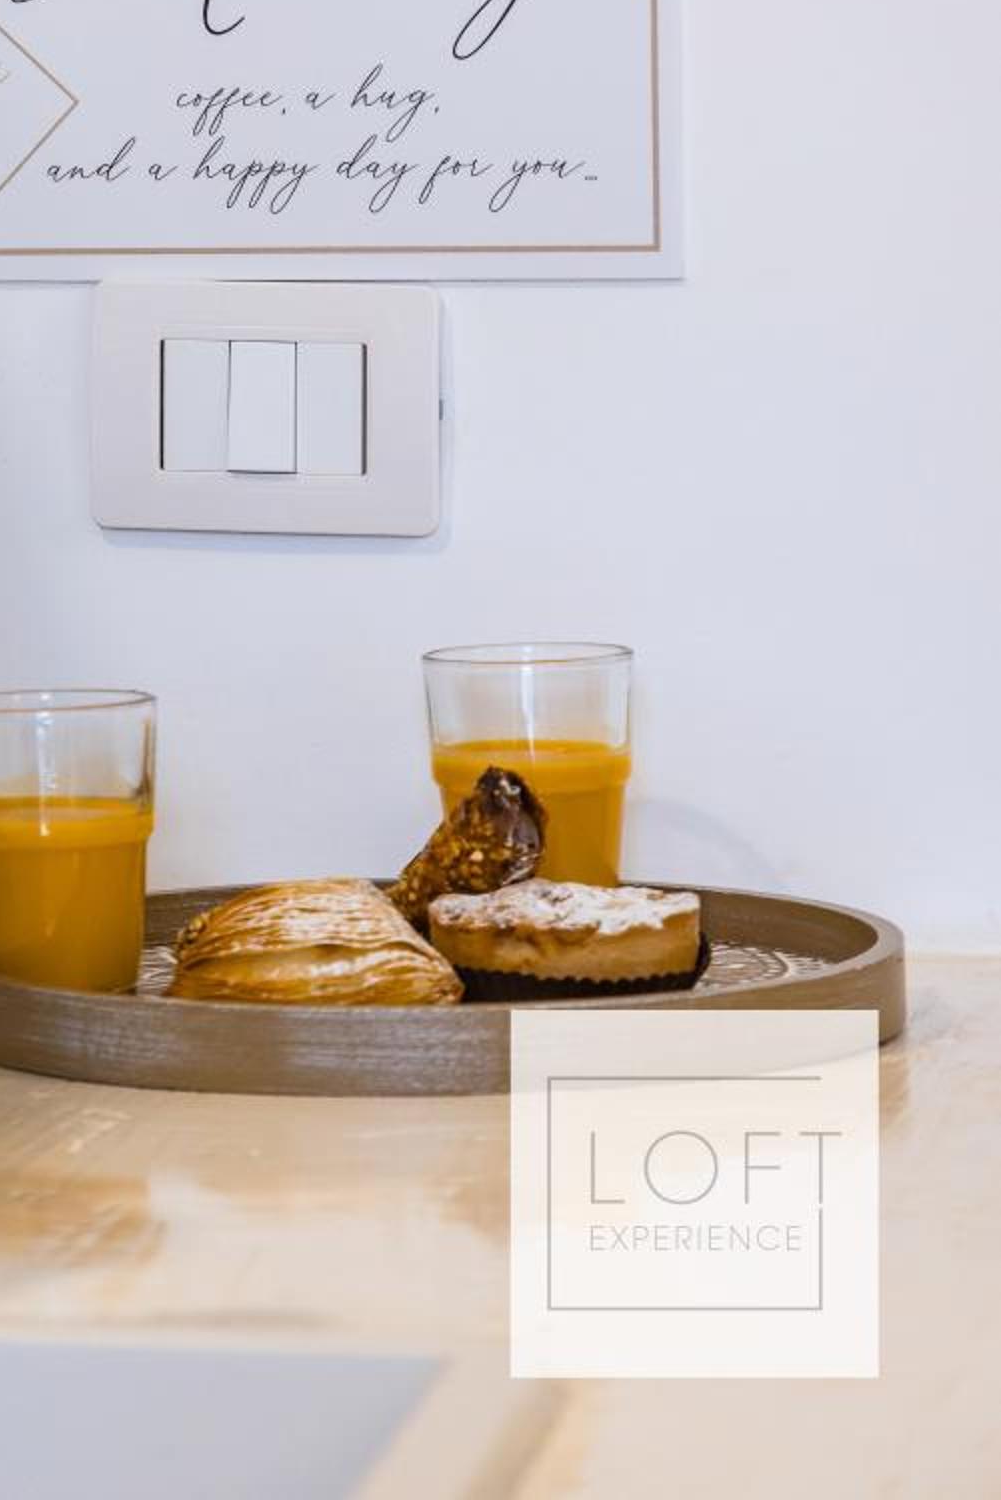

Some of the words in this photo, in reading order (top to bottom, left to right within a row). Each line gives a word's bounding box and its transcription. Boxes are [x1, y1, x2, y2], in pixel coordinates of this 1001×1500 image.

[176, 87, 286, 136] coffee,
[305, 91, 335, 110] a
[46, 136, 135, 182] and
[148, 164, 177, 181] a
[192, 135, 319, 215] happy
[336, 134, 419, 213] day
[418, 155, 494, 205] for
